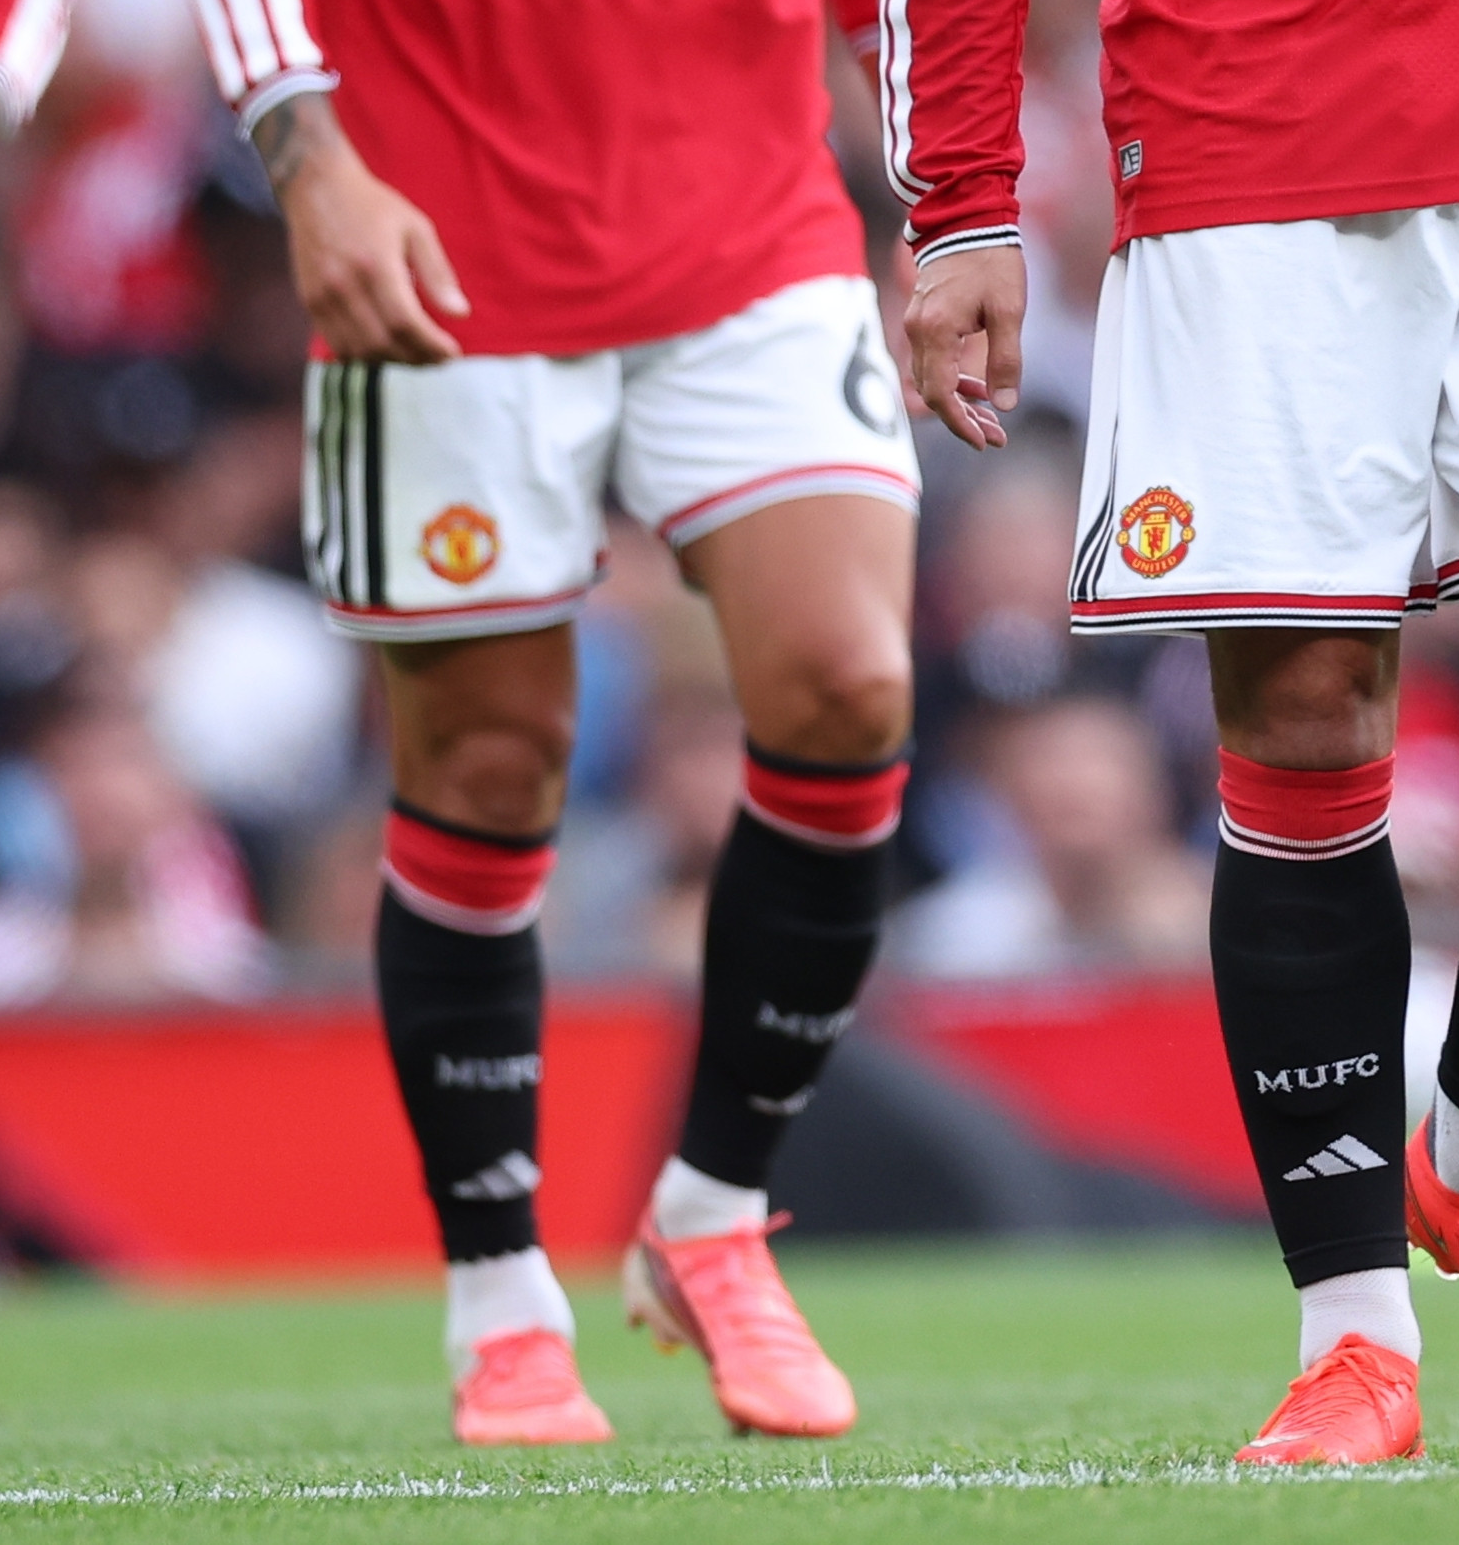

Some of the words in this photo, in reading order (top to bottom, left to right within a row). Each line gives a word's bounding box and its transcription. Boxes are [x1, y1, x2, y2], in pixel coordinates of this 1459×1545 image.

[843, 322, 899, 437] 6
[1125, 493, 1189, 524] MANCHESTER
[1131, 555, 1178, 573] UNITED
[1253, 1052, 1380, 1094] MUFC
